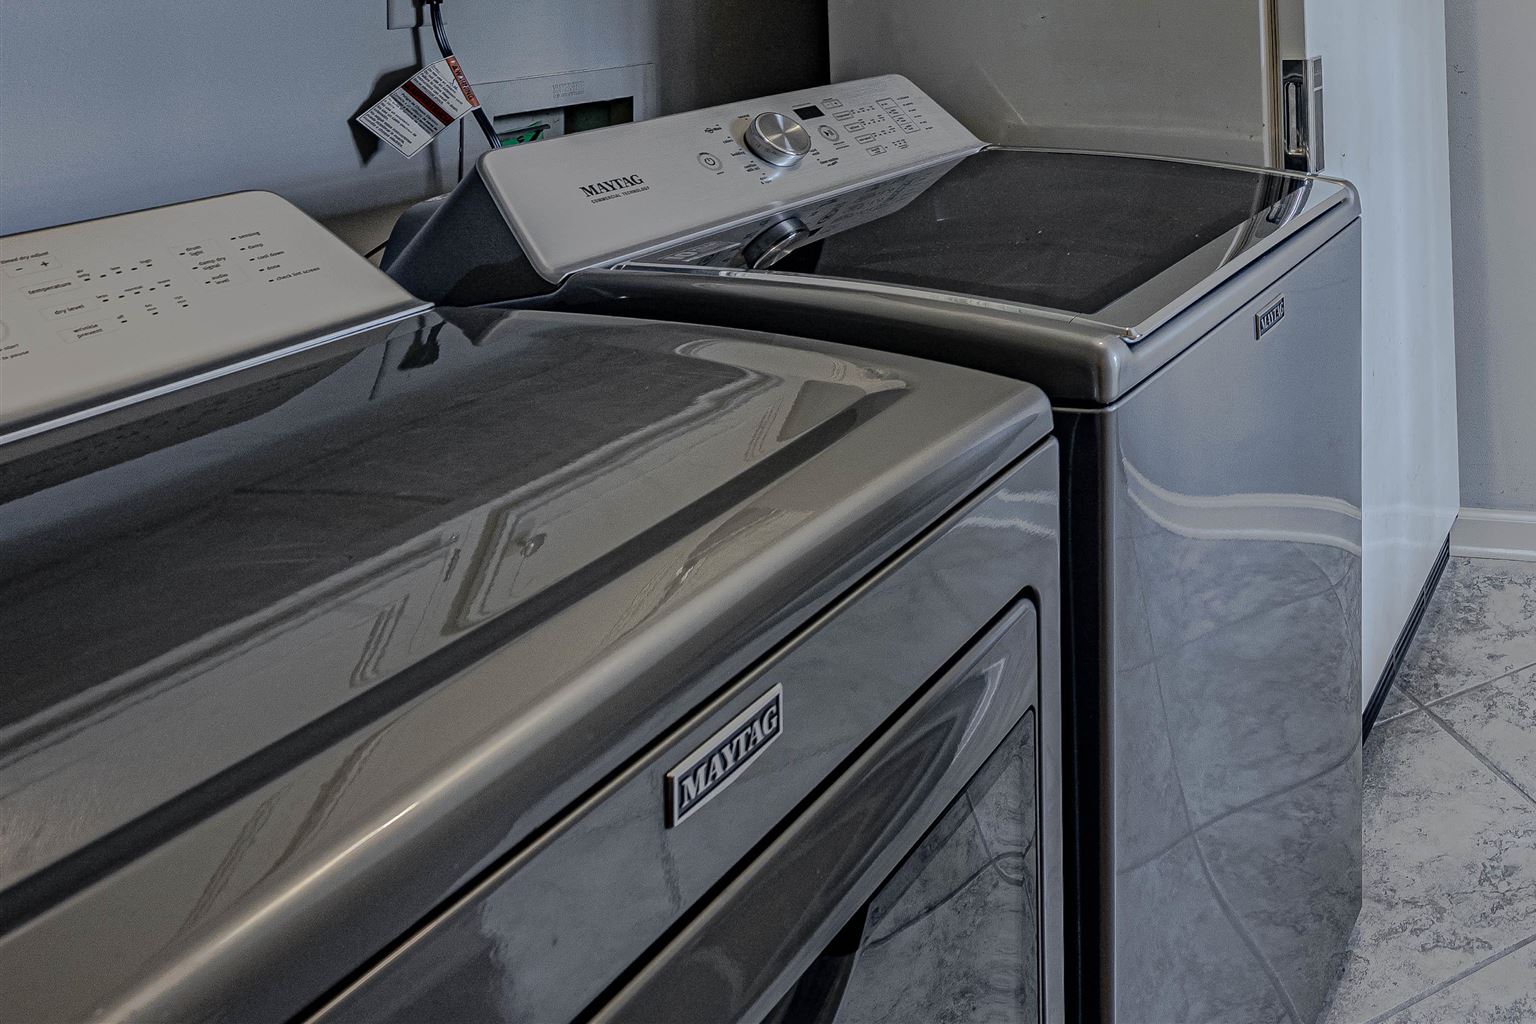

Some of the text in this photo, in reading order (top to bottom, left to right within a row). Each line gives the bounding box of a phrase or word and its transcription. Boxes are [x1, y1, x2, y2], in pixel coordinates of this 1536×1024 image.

[579, 174, 644, 197] MAYTAG
[591, 193, 621, 204] COMMERCIAL
[238, 231, 261, 239] sensing
[28, 282, 72, 295] temperature
[67, 304, 85, 312] level
[1261, 302, 1284, 331] MAYTAG
[73, 324, 98, 333] wrinkle
[77, 328, 104, 339] prevent
[681, 704, 779, 808] MAYTAG
